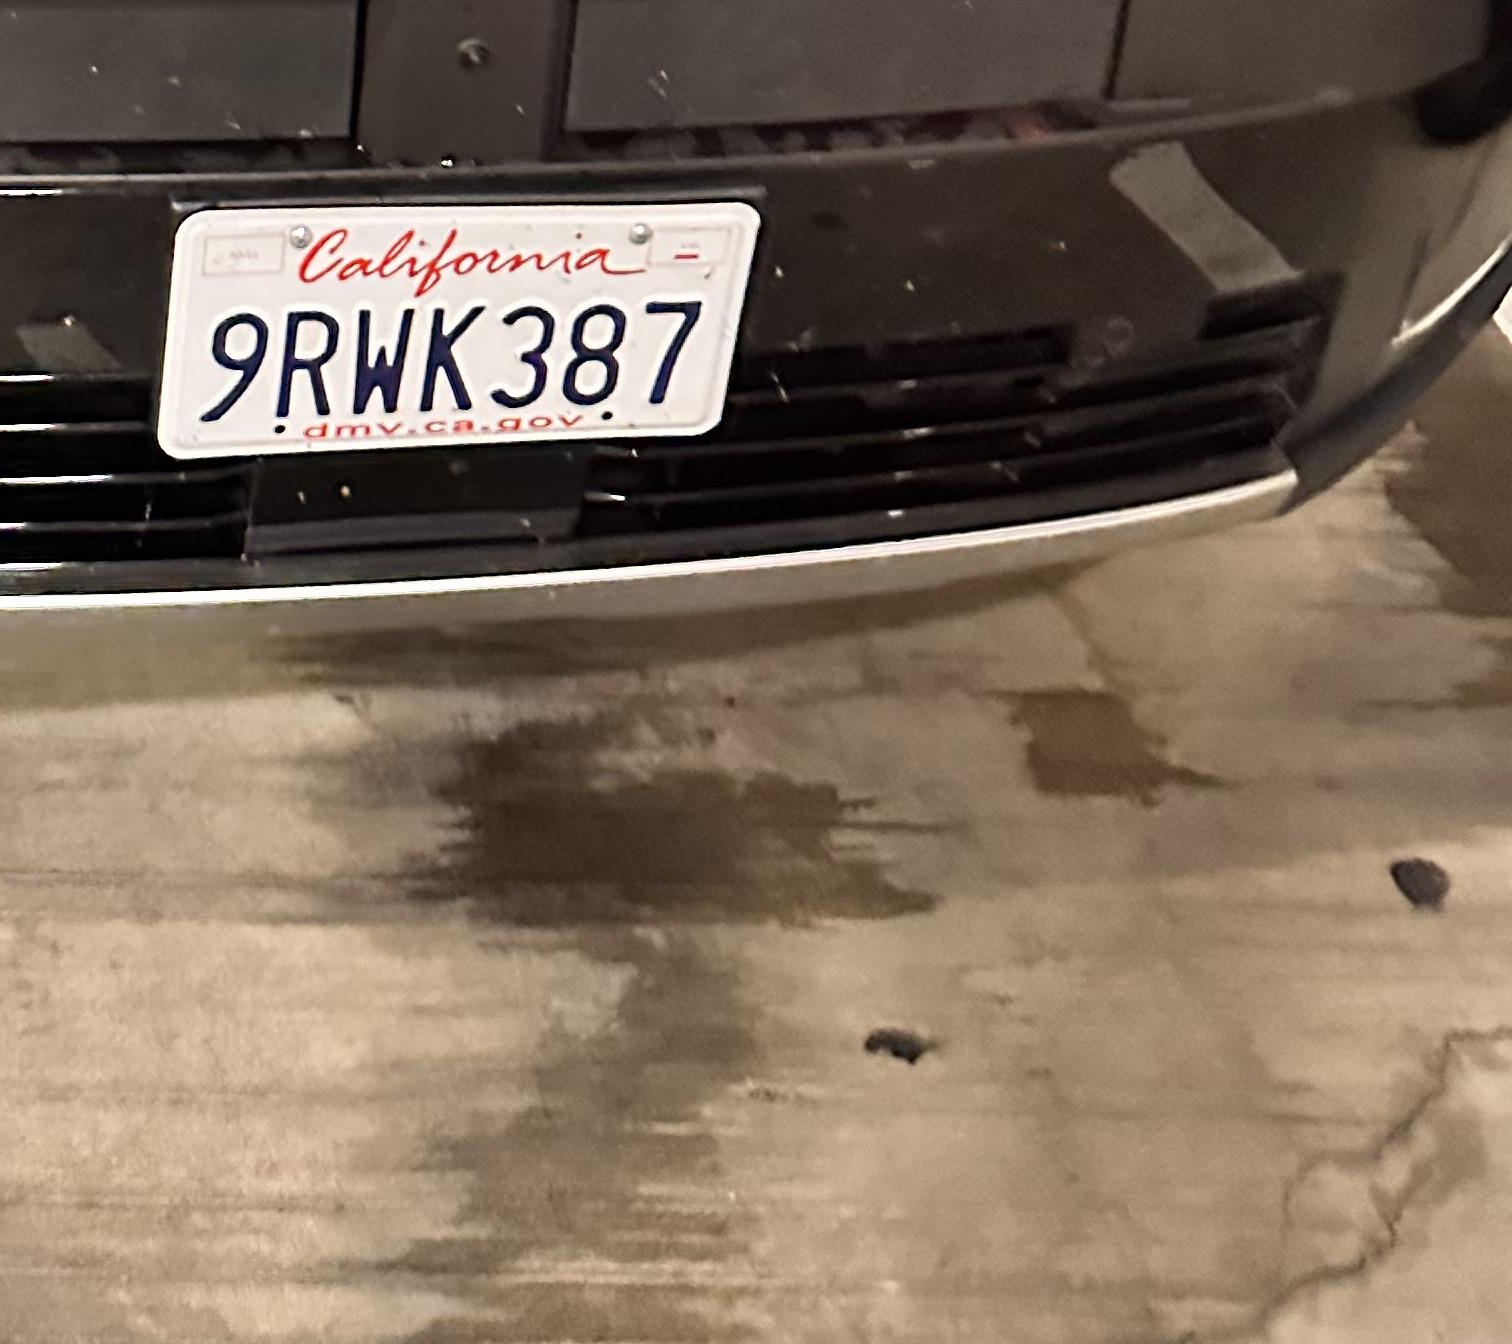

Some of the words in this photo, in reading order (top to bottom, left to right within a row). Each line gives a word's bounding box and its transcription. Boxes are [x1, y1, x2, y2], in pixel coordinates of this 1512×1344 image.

[297, 227, 648, 299] California
[199, 300, 703, 423] 9RWK387
[303, 413, 584, 440] dmv.ca.gov
